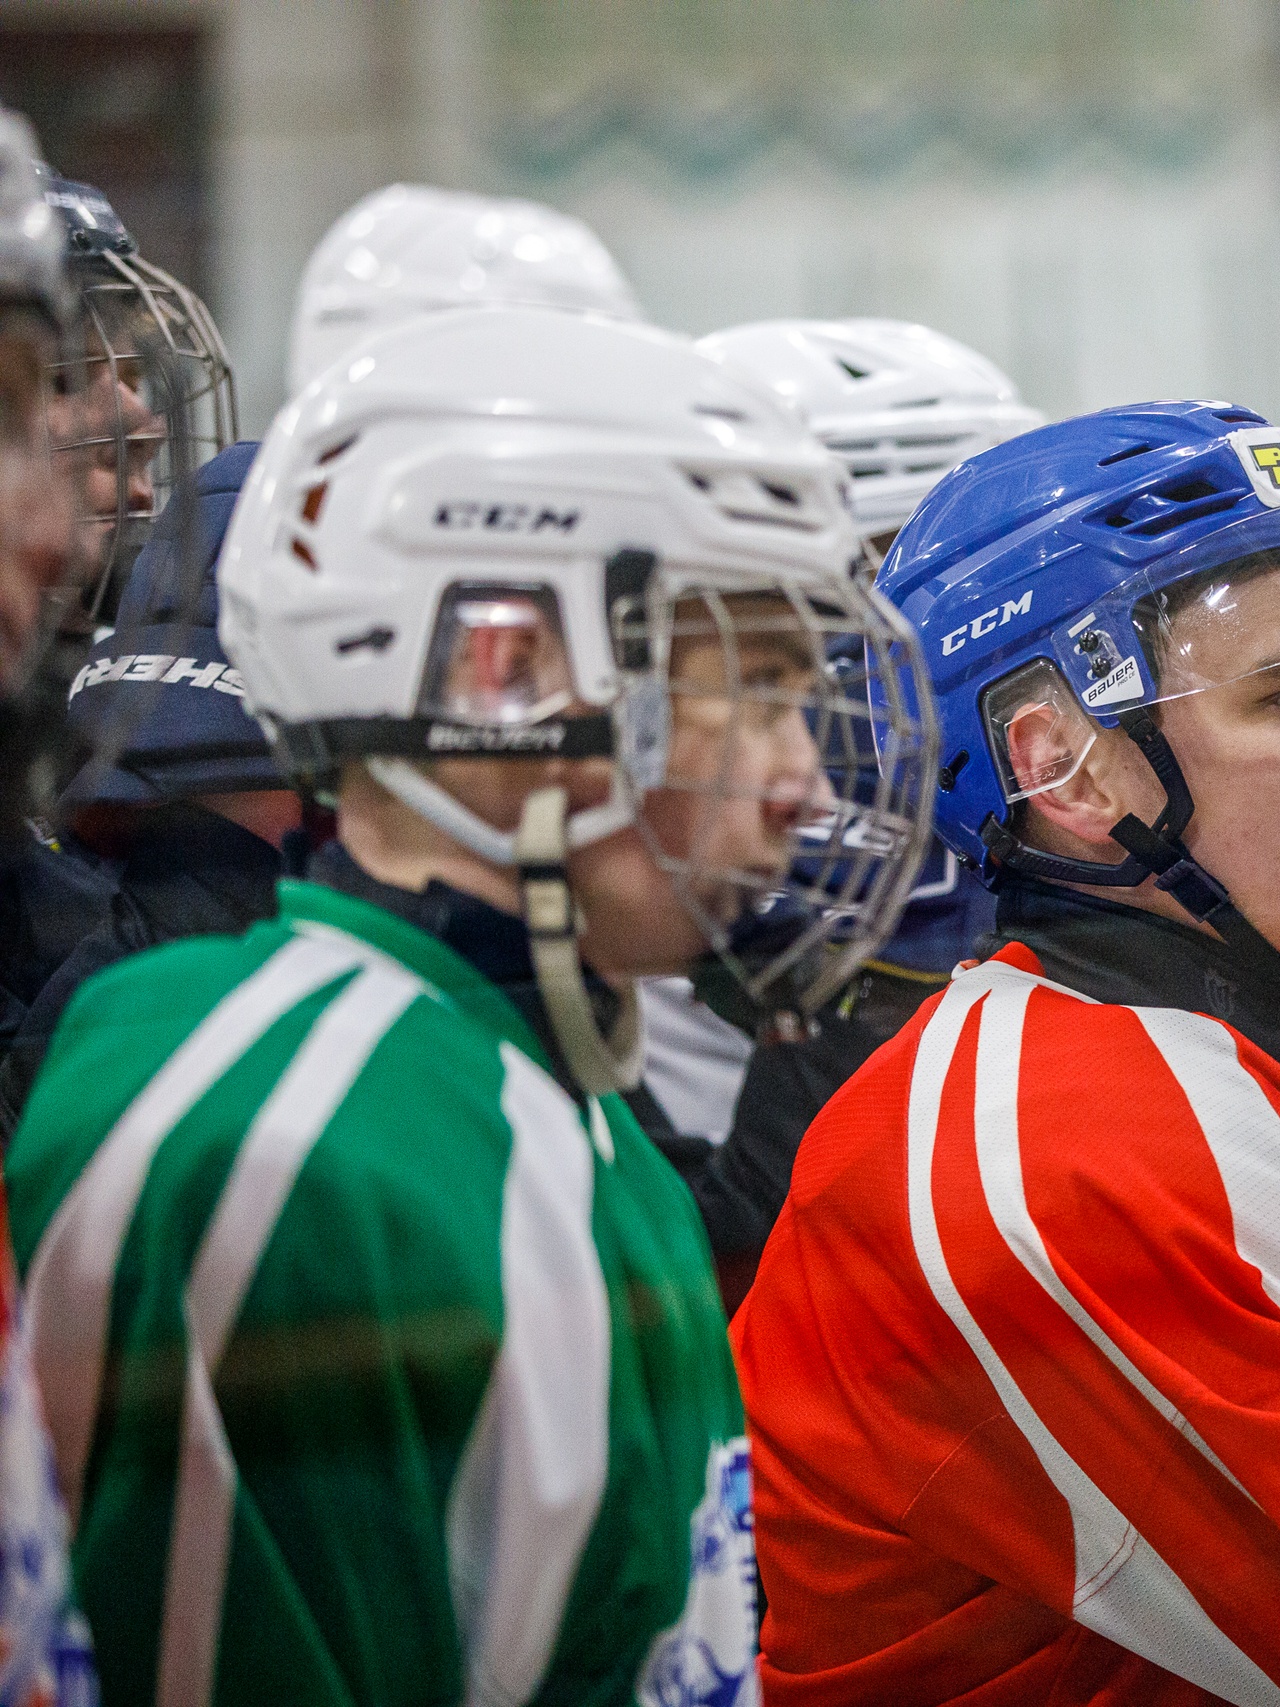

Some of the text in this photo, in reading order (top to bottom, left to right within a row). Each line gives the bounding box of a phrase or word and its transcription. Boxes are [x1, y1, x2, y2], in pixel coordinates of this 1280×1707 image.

[434, 503, 582, 534] CCM
[940, 590, 1033, 656] CCM
[1088, 661, 1134, 703] BAUER
